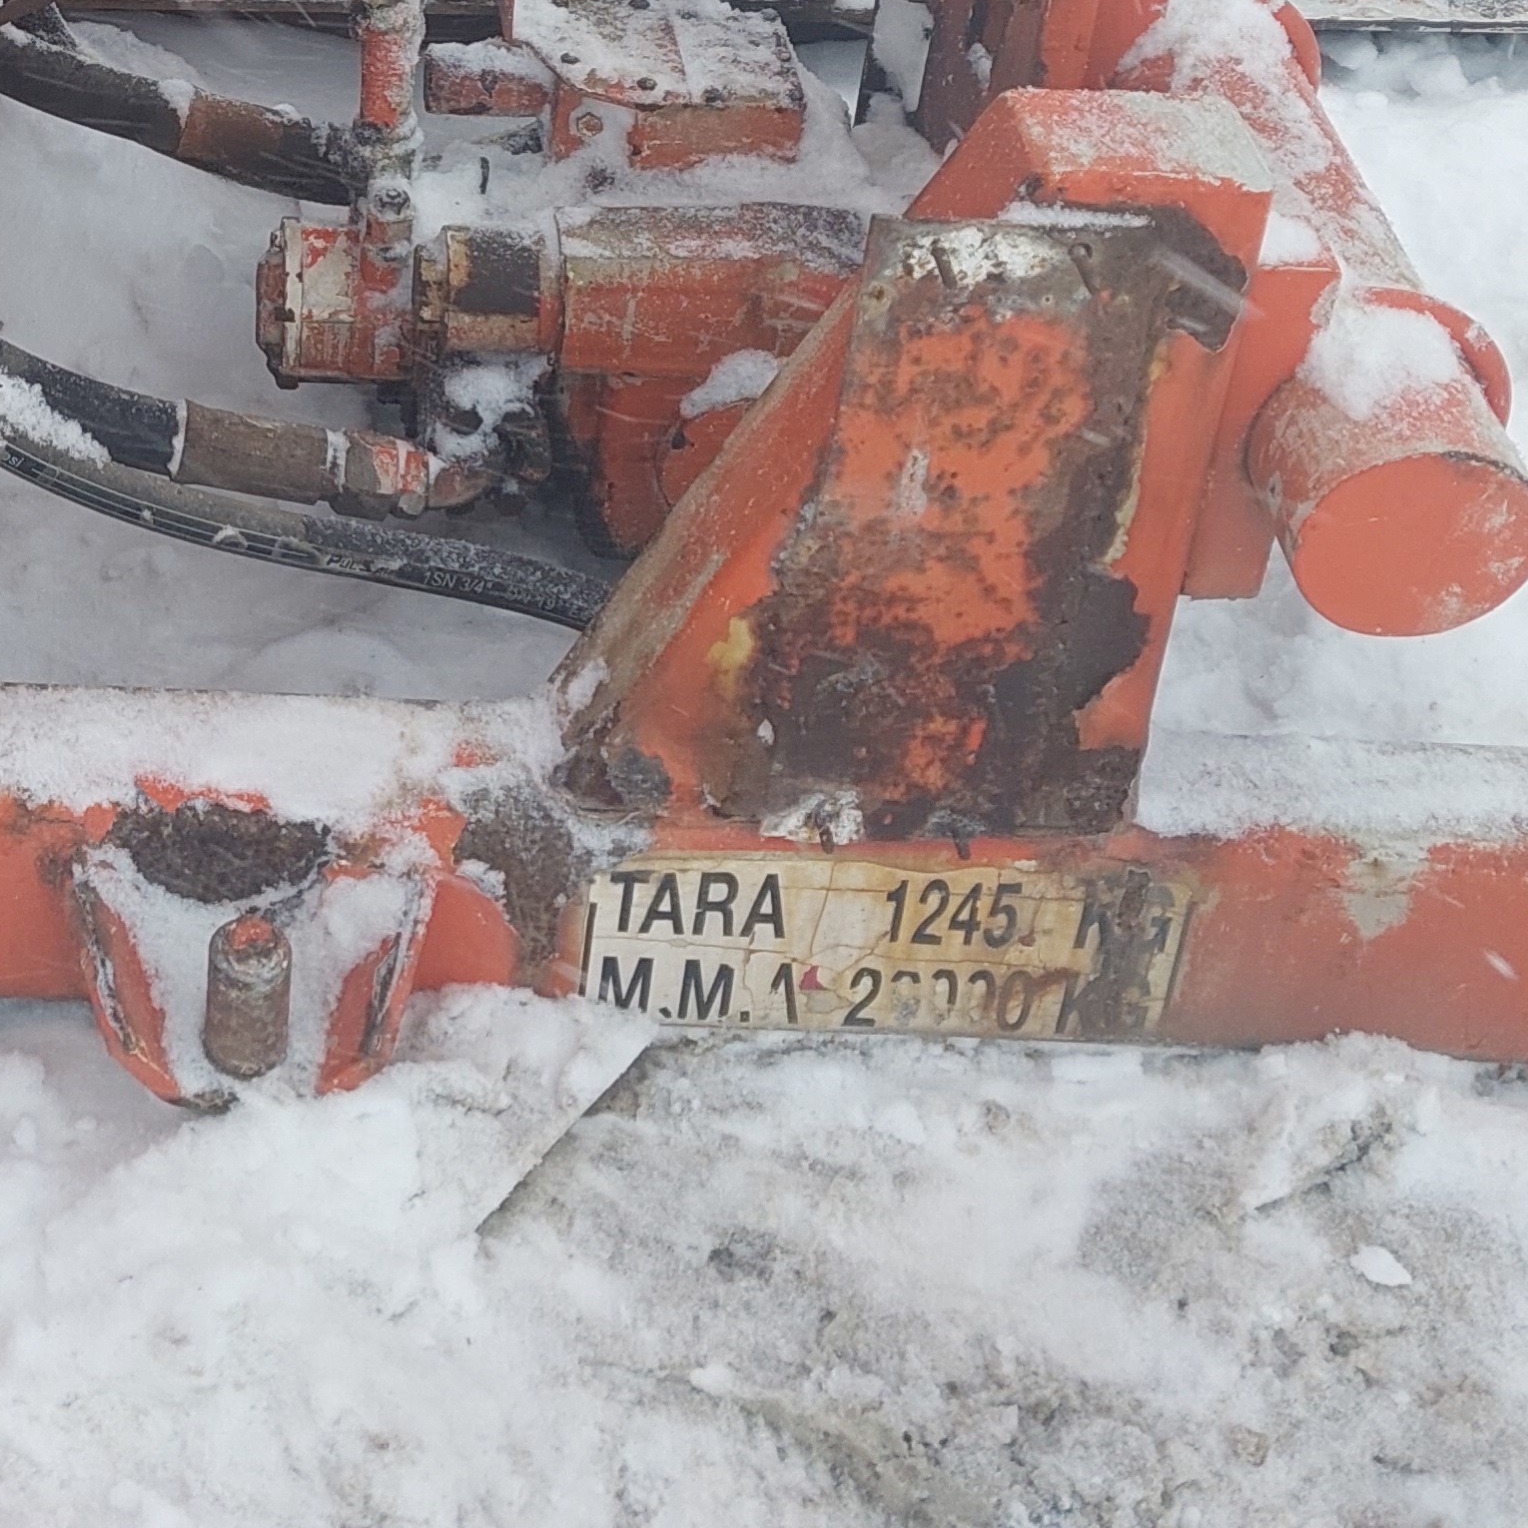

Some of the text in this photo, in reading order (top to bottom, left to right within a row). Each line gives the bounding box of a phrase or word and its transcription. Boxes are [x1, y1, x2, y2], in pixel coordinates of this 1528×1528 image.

[423, 571, 458, 590] 1SN
[610, 870, 785, 939] TARA
[885, 878, 1023, 949] 1245
